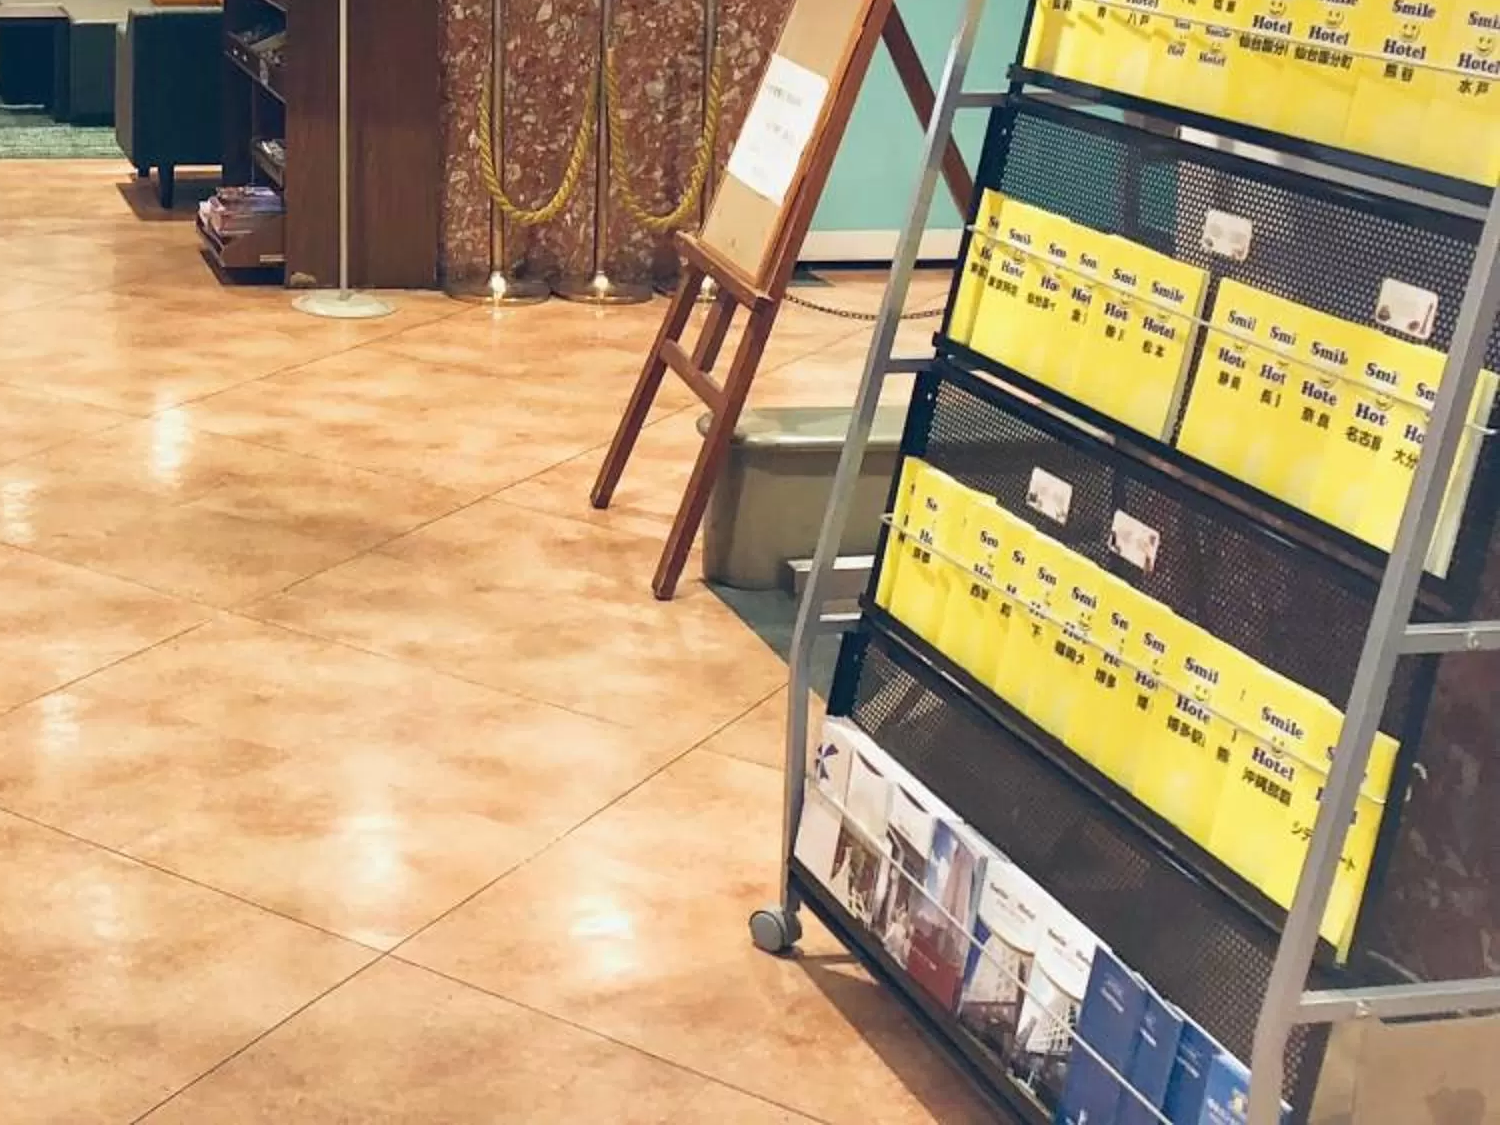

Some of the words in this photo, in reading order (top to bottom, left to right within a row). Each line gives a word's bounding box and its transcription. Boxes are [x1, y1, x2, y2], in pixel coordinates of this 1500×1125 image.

[1252, 14, 1293, 35] Hotel
[1468, 11, 1500, 29] Smi
[1239, 35, 1288, 56] 仙台国分
[1308, 25, 1350, 46] Hotel
[1383, 38, 1427, 60] Hotel
[1459, 78, 1490, 97] 水戸
[1112, 268, 1136, 287] Smi
[1152, 280, 1185, 303] Smile
[1104, 302, 1128, 321] Hot
[1228, 310, 1255, 332] Smil
[1143, 316, 1175, 341] Hotel
[1270, 326, 1296, 346] Smi
[1259, 364, 1287, 385] Hot
[1365, 362, 1397, 385] Smi
[1301, 380, 1338, 406] Hote
[1355, 403, 1388, 427] Hot
[1072, 586, 1097, 609] Smi
[1184, 657, 1219, 684] Smil
[1176, 694, 1211, 724] Hote
[1261, 706, 1304, 739] Smile
[1252, 746, 1295, 782] Hotel
